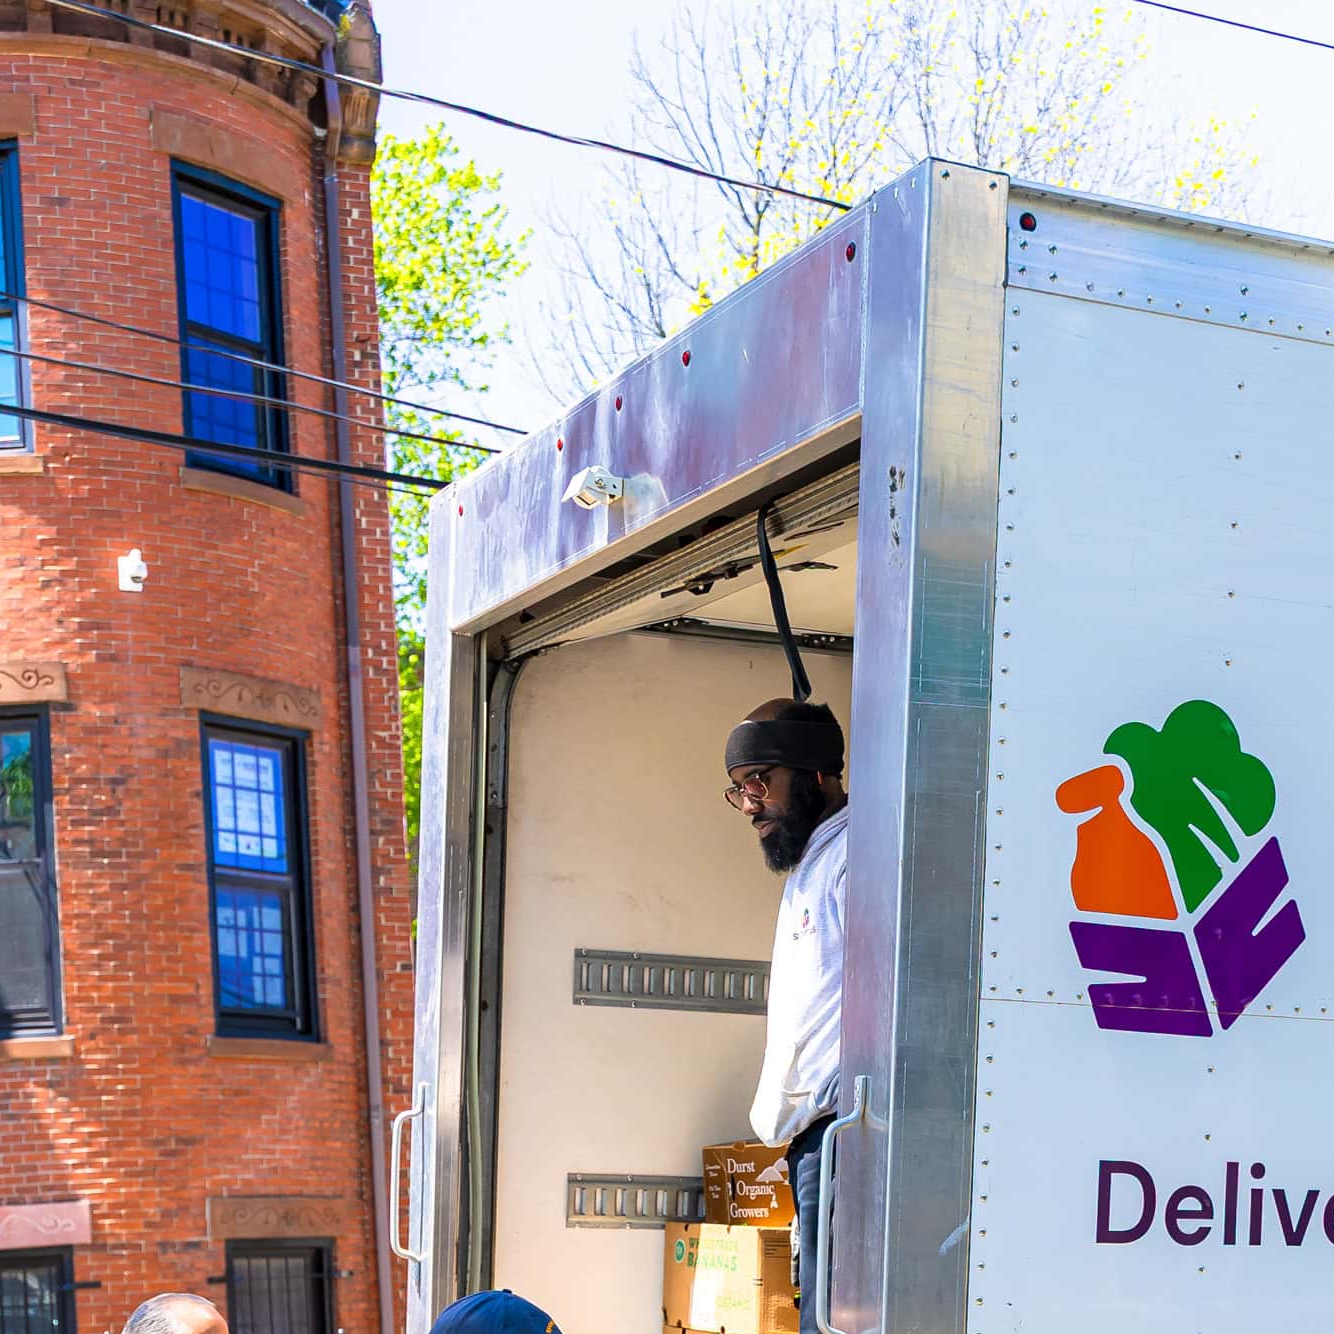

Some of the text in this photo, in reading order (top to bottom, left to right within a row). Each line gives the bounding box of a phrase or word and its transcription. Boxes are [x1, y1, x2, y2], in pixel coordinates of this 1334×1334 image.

[727, 1158, 755, 1173] Durst
[736, 1180, 774, 1200] Organic
[730, 1203, 769, 1218] Growers
